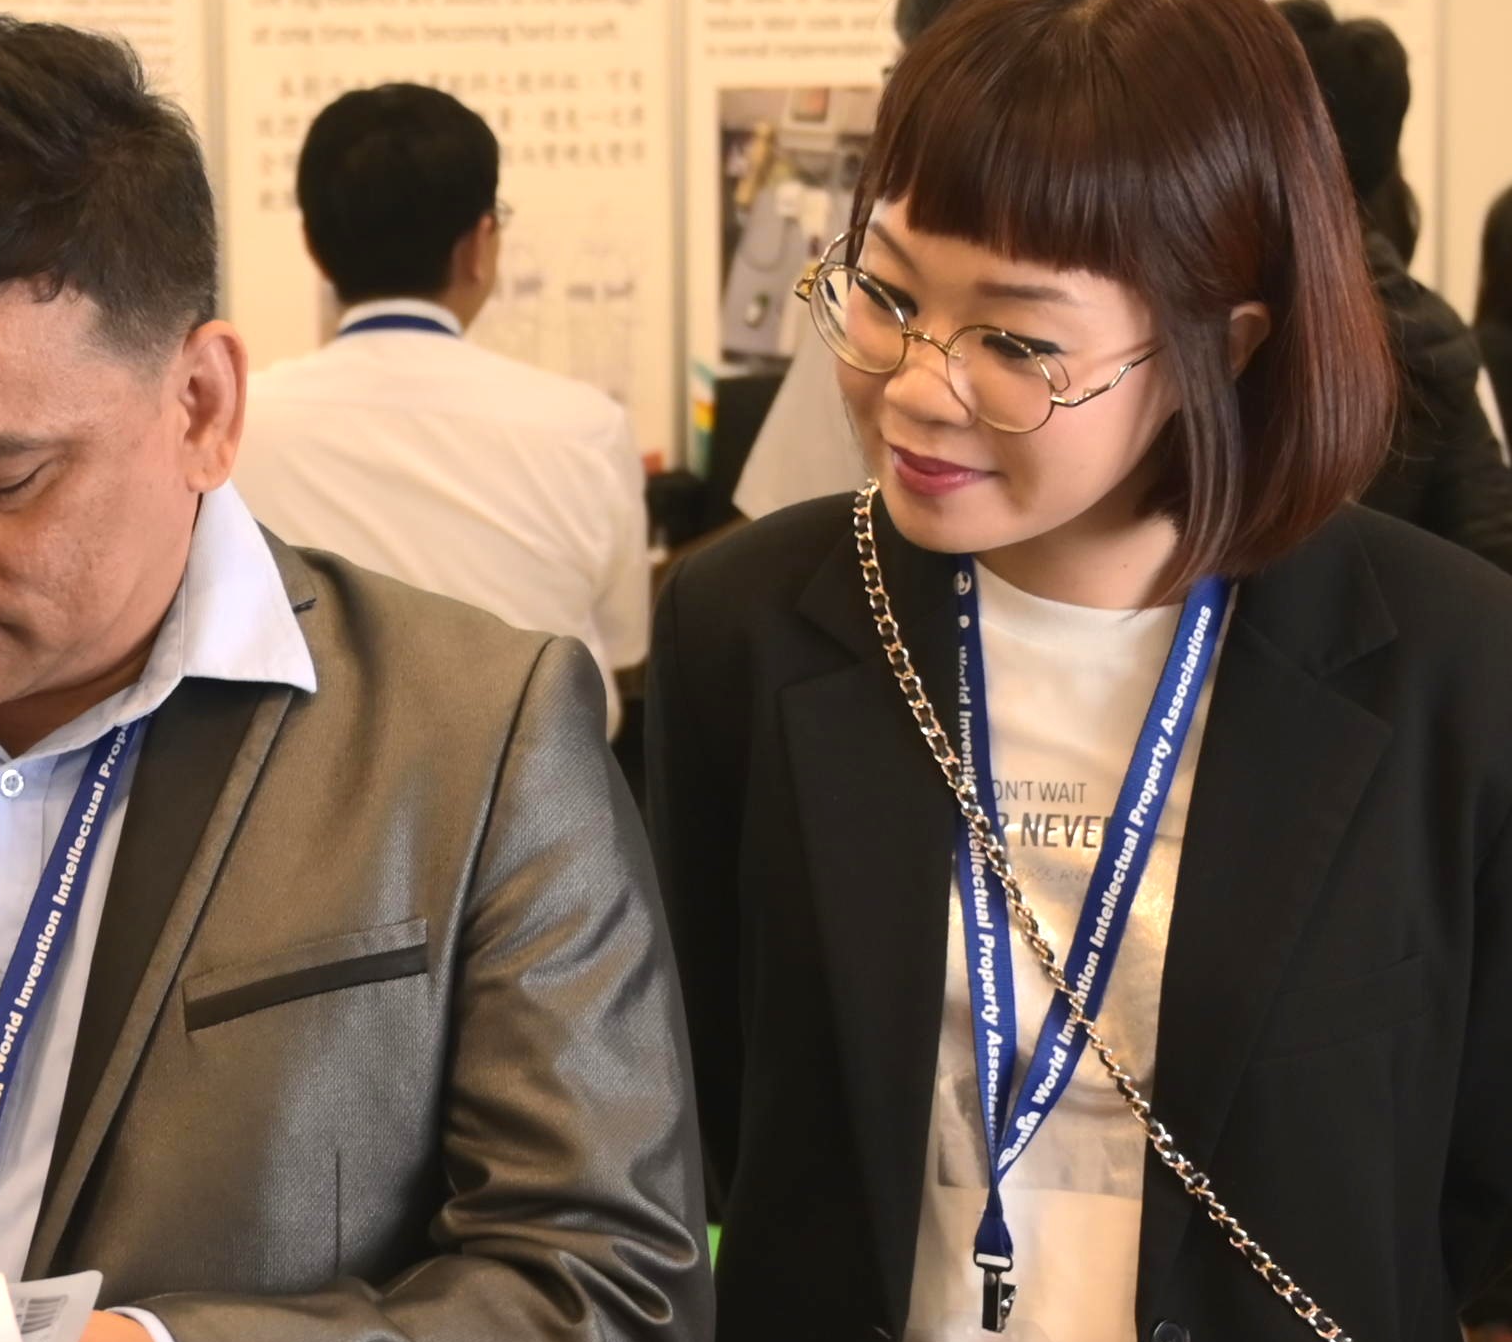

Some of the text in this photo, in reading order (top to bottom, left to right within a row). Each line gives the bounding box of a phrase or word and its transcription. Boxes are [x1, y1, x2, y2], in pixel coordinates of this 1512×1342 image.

[993, 780, 1088, 804] ON'T WAIT
[14, 908, 61, 1011] Invention
[53, 780, 107, 908] Intellectual
[966, 822, 994, 929] tellectual
[1030, 1043, 1070, 1107] World
[1088, 824, 1138, 948] Intellectual
[1128, 735, 1171, 828] Property
[1160, 604, 1212, 733] Associations
[978, 923, 999, 1028] Property
